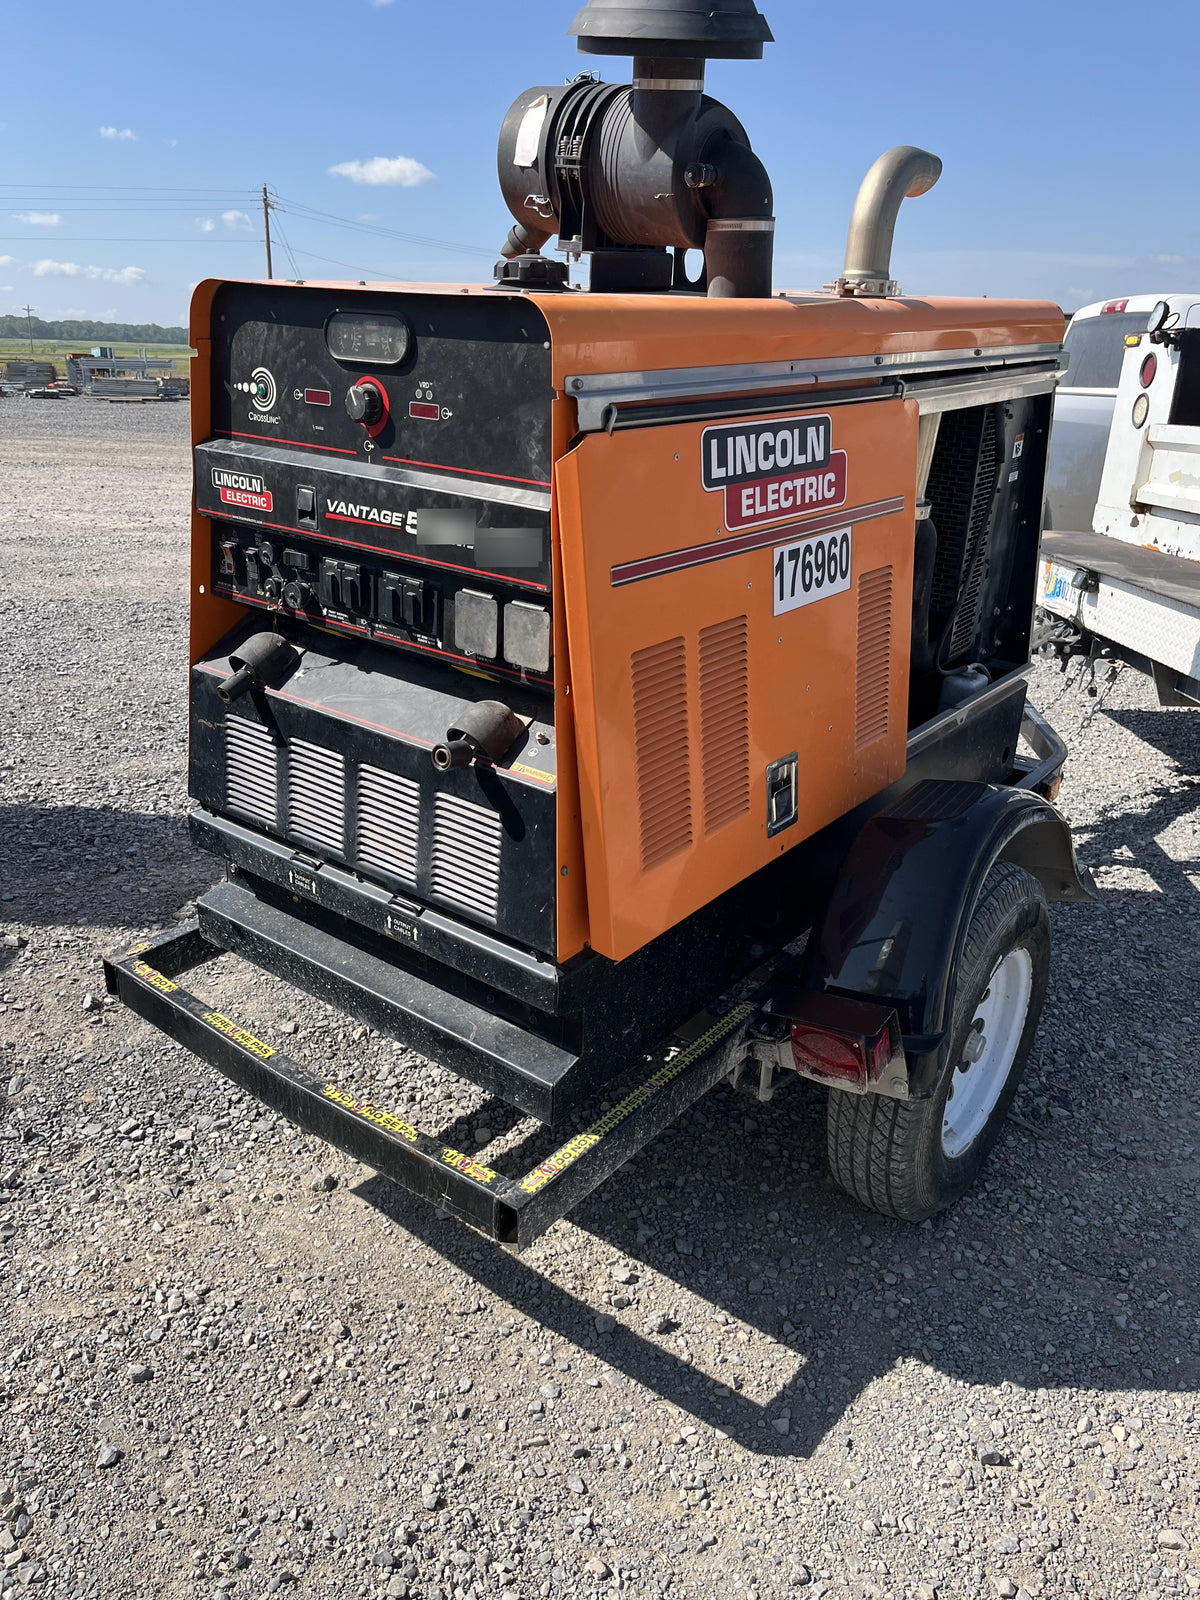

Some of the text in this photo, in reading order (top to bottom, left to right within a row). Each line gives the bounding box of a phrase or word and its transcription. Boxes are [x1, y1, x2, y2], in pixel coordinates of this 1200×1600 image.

[708, 425, 824, 480] LINCOLN
[214, 471, 261, 493] LINCOLN
[741, 472, 836, 518] ELECTRIC
[226, 490, 267, 508] ELECTRIC
[326, 498, 403, 527] VANTAGE
[775, 532, 850, 602] 176960
[393, 918, 411, 930] OUTPUT
[207, 1012, 271, 1056] HERE NE PAS
[364, 1107, 385, 1120] NO
[382, 1117, 401, 1130] SE
[555, 1151, 572, 1165] DO
